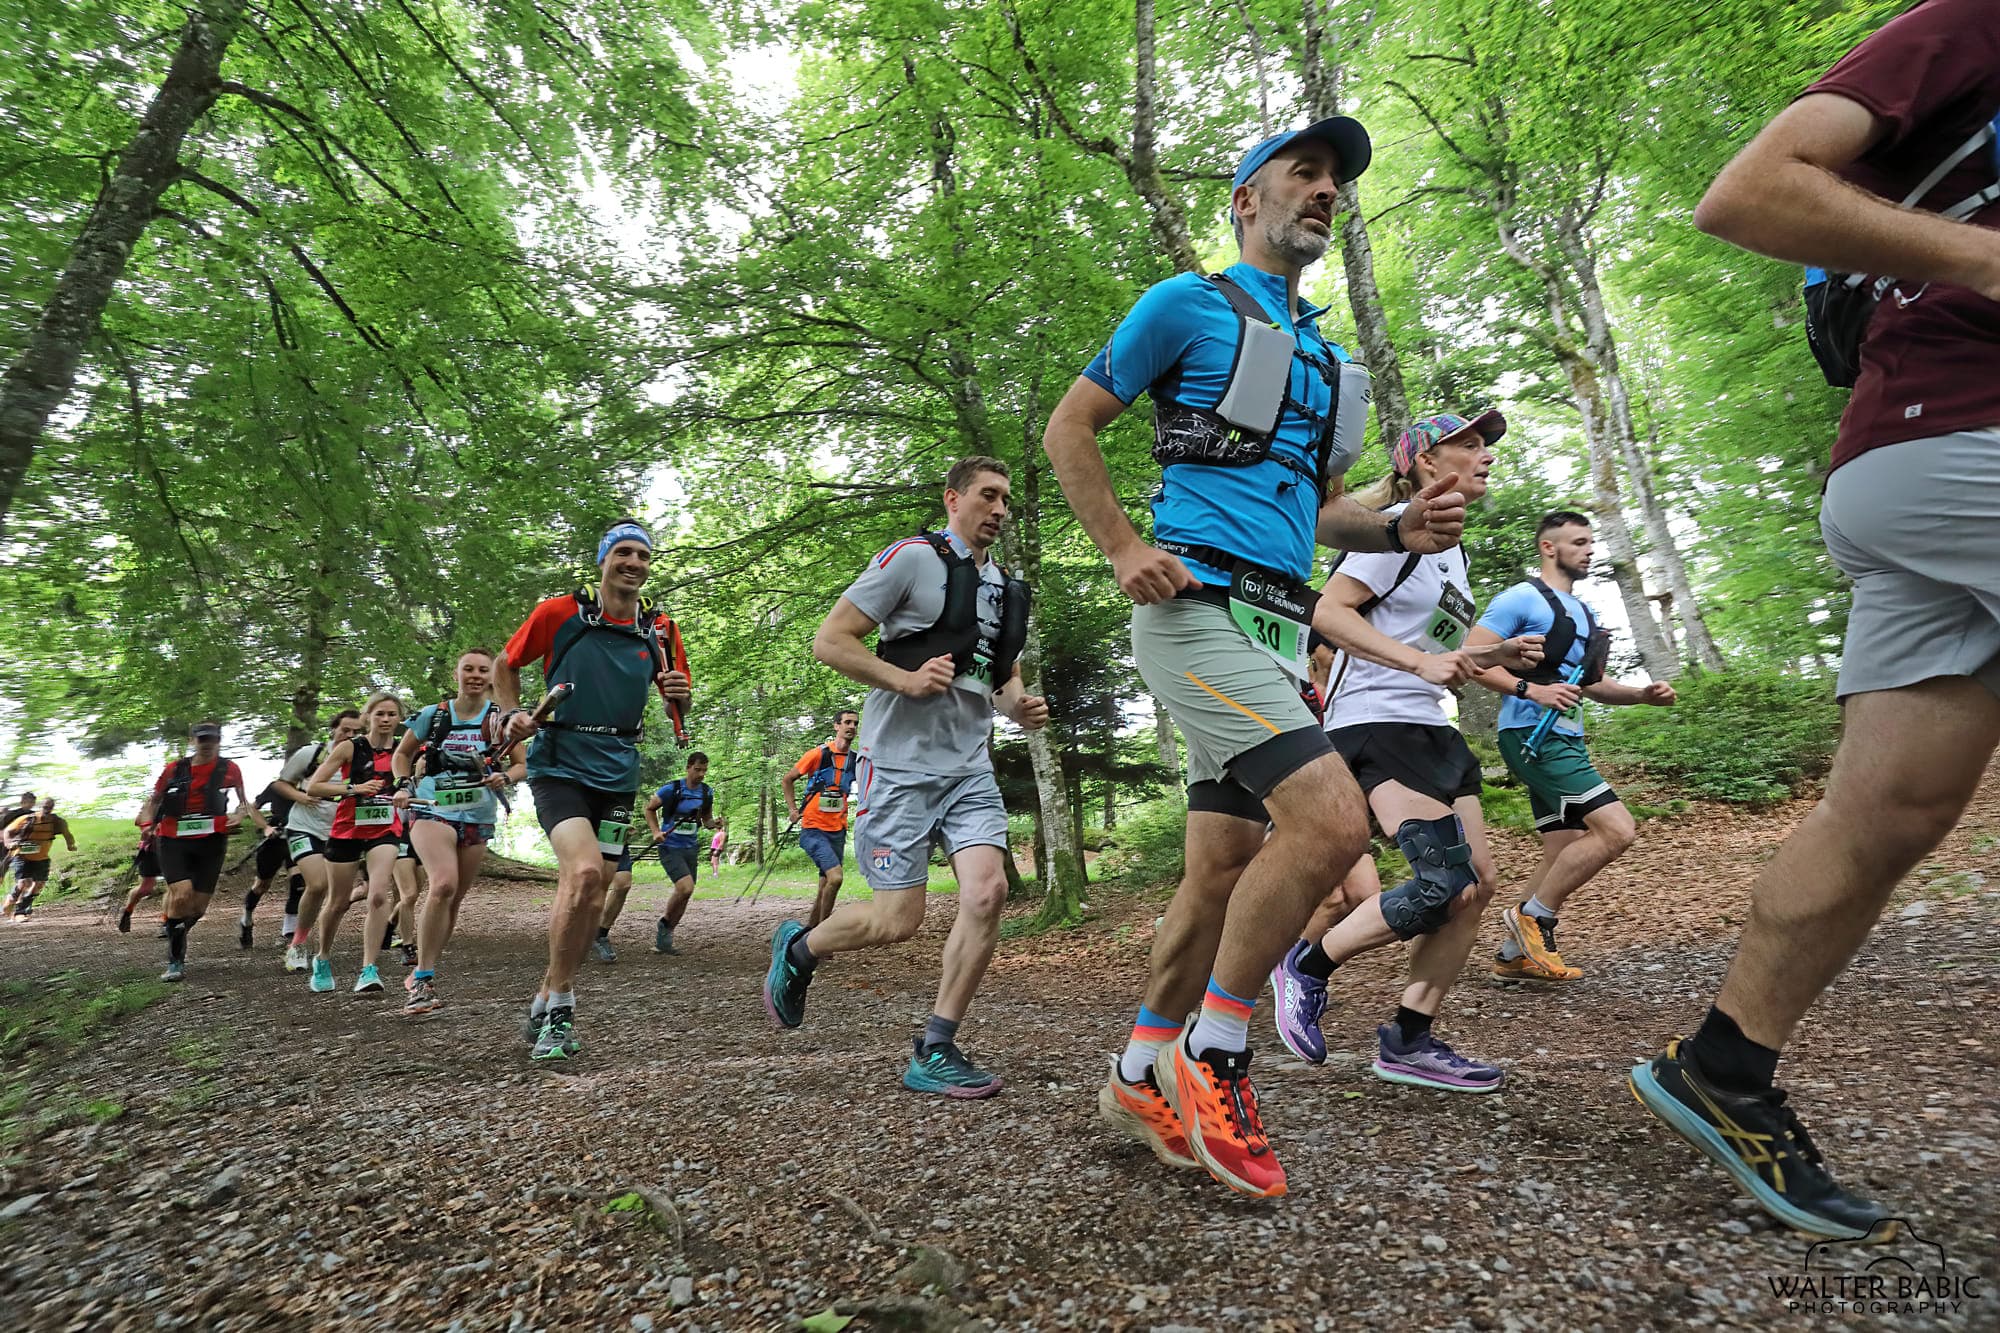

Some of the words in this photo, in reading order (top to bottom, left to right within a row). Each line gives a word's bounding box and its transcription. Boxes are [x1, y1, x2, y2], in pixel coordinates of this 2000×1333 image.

[1274, 596, 1306, 615] RUNNING
[1252, 615, 1281, 651] 30
[1433, 618, 1458, 642] 67
[444, 791, 474, 805] 105
[1284, 977, 1295, 1010] HOKA
